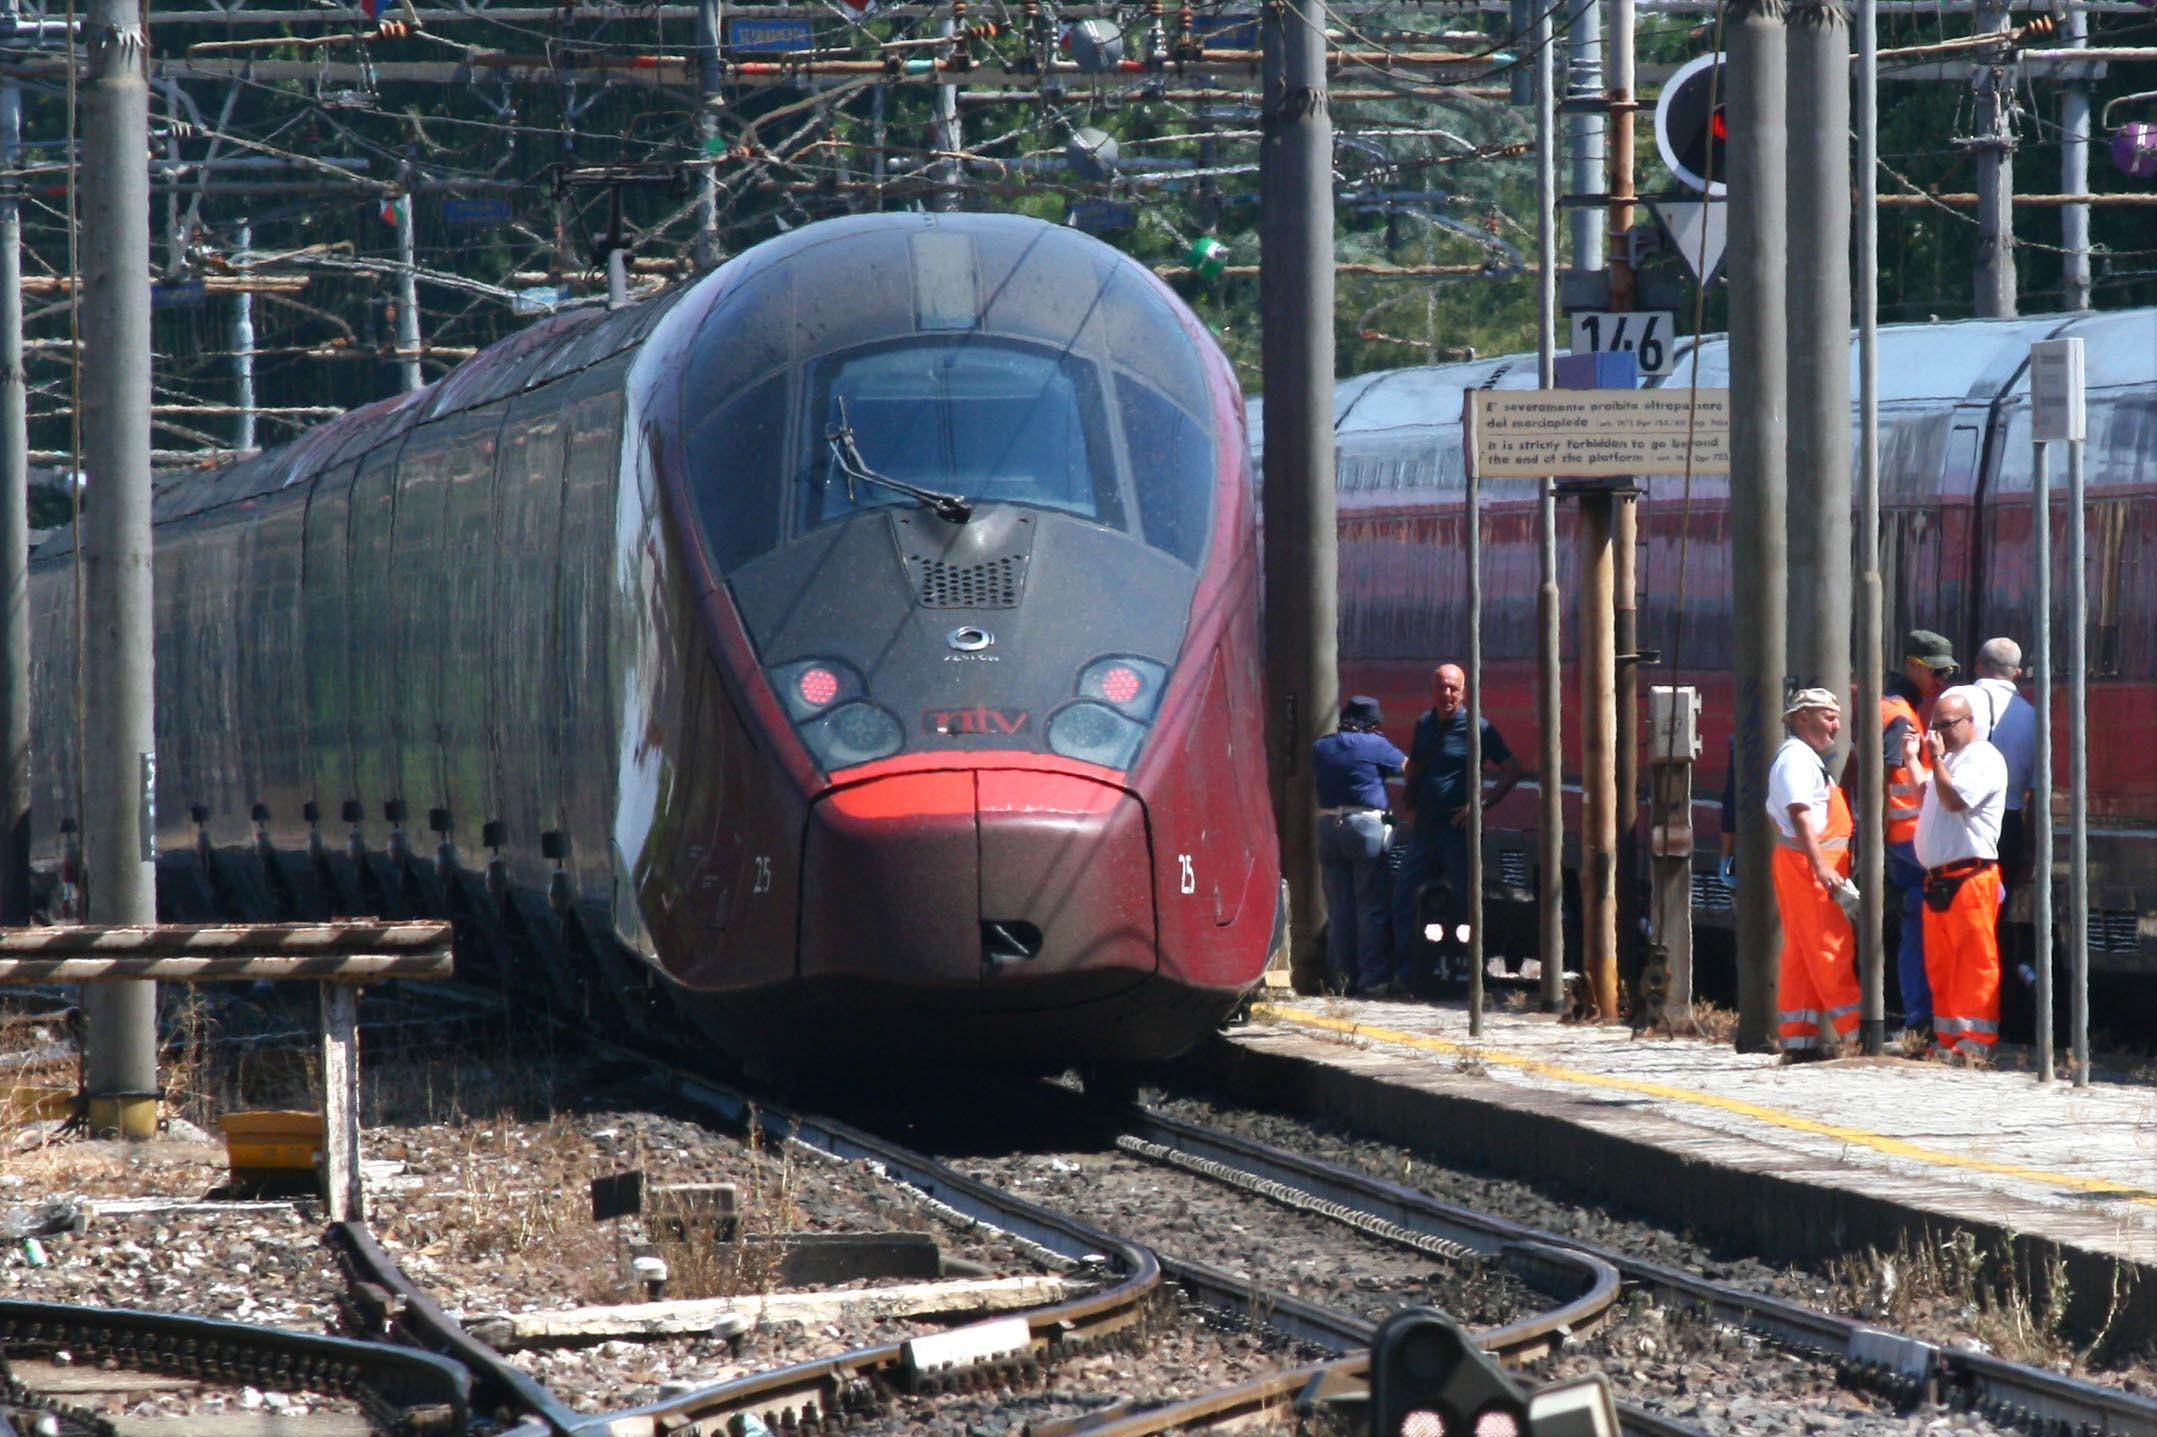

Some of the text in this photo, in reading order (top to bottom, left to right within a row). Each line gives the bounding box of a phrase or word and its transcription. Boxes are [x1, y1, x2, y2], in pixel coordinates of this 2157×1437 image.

[1581, 315, 1663, 371] 146
[1504, 402, 1585, 412] severamente
[1644, 400, 1723, 412] oltrepasare
[1512, 417, 1588, 429] marciapiede
[1503, 441, 1513, 450] is
[1519, 440, 1560, 452] strictly
[1567, 437, 1628, 450] forbidden
[1632, 439, 1645, 449] to
[1651, 441, 1666, 451] go
[1488, 454, 1509, 465] the
[1515, 454, 1538, 465] end
[1543, 454, 1556, 464] of
[1562, 453, 1583, 464] the
[1589, 451, 1643, 465] platform
[1178, 854, 1195, 894] 25
